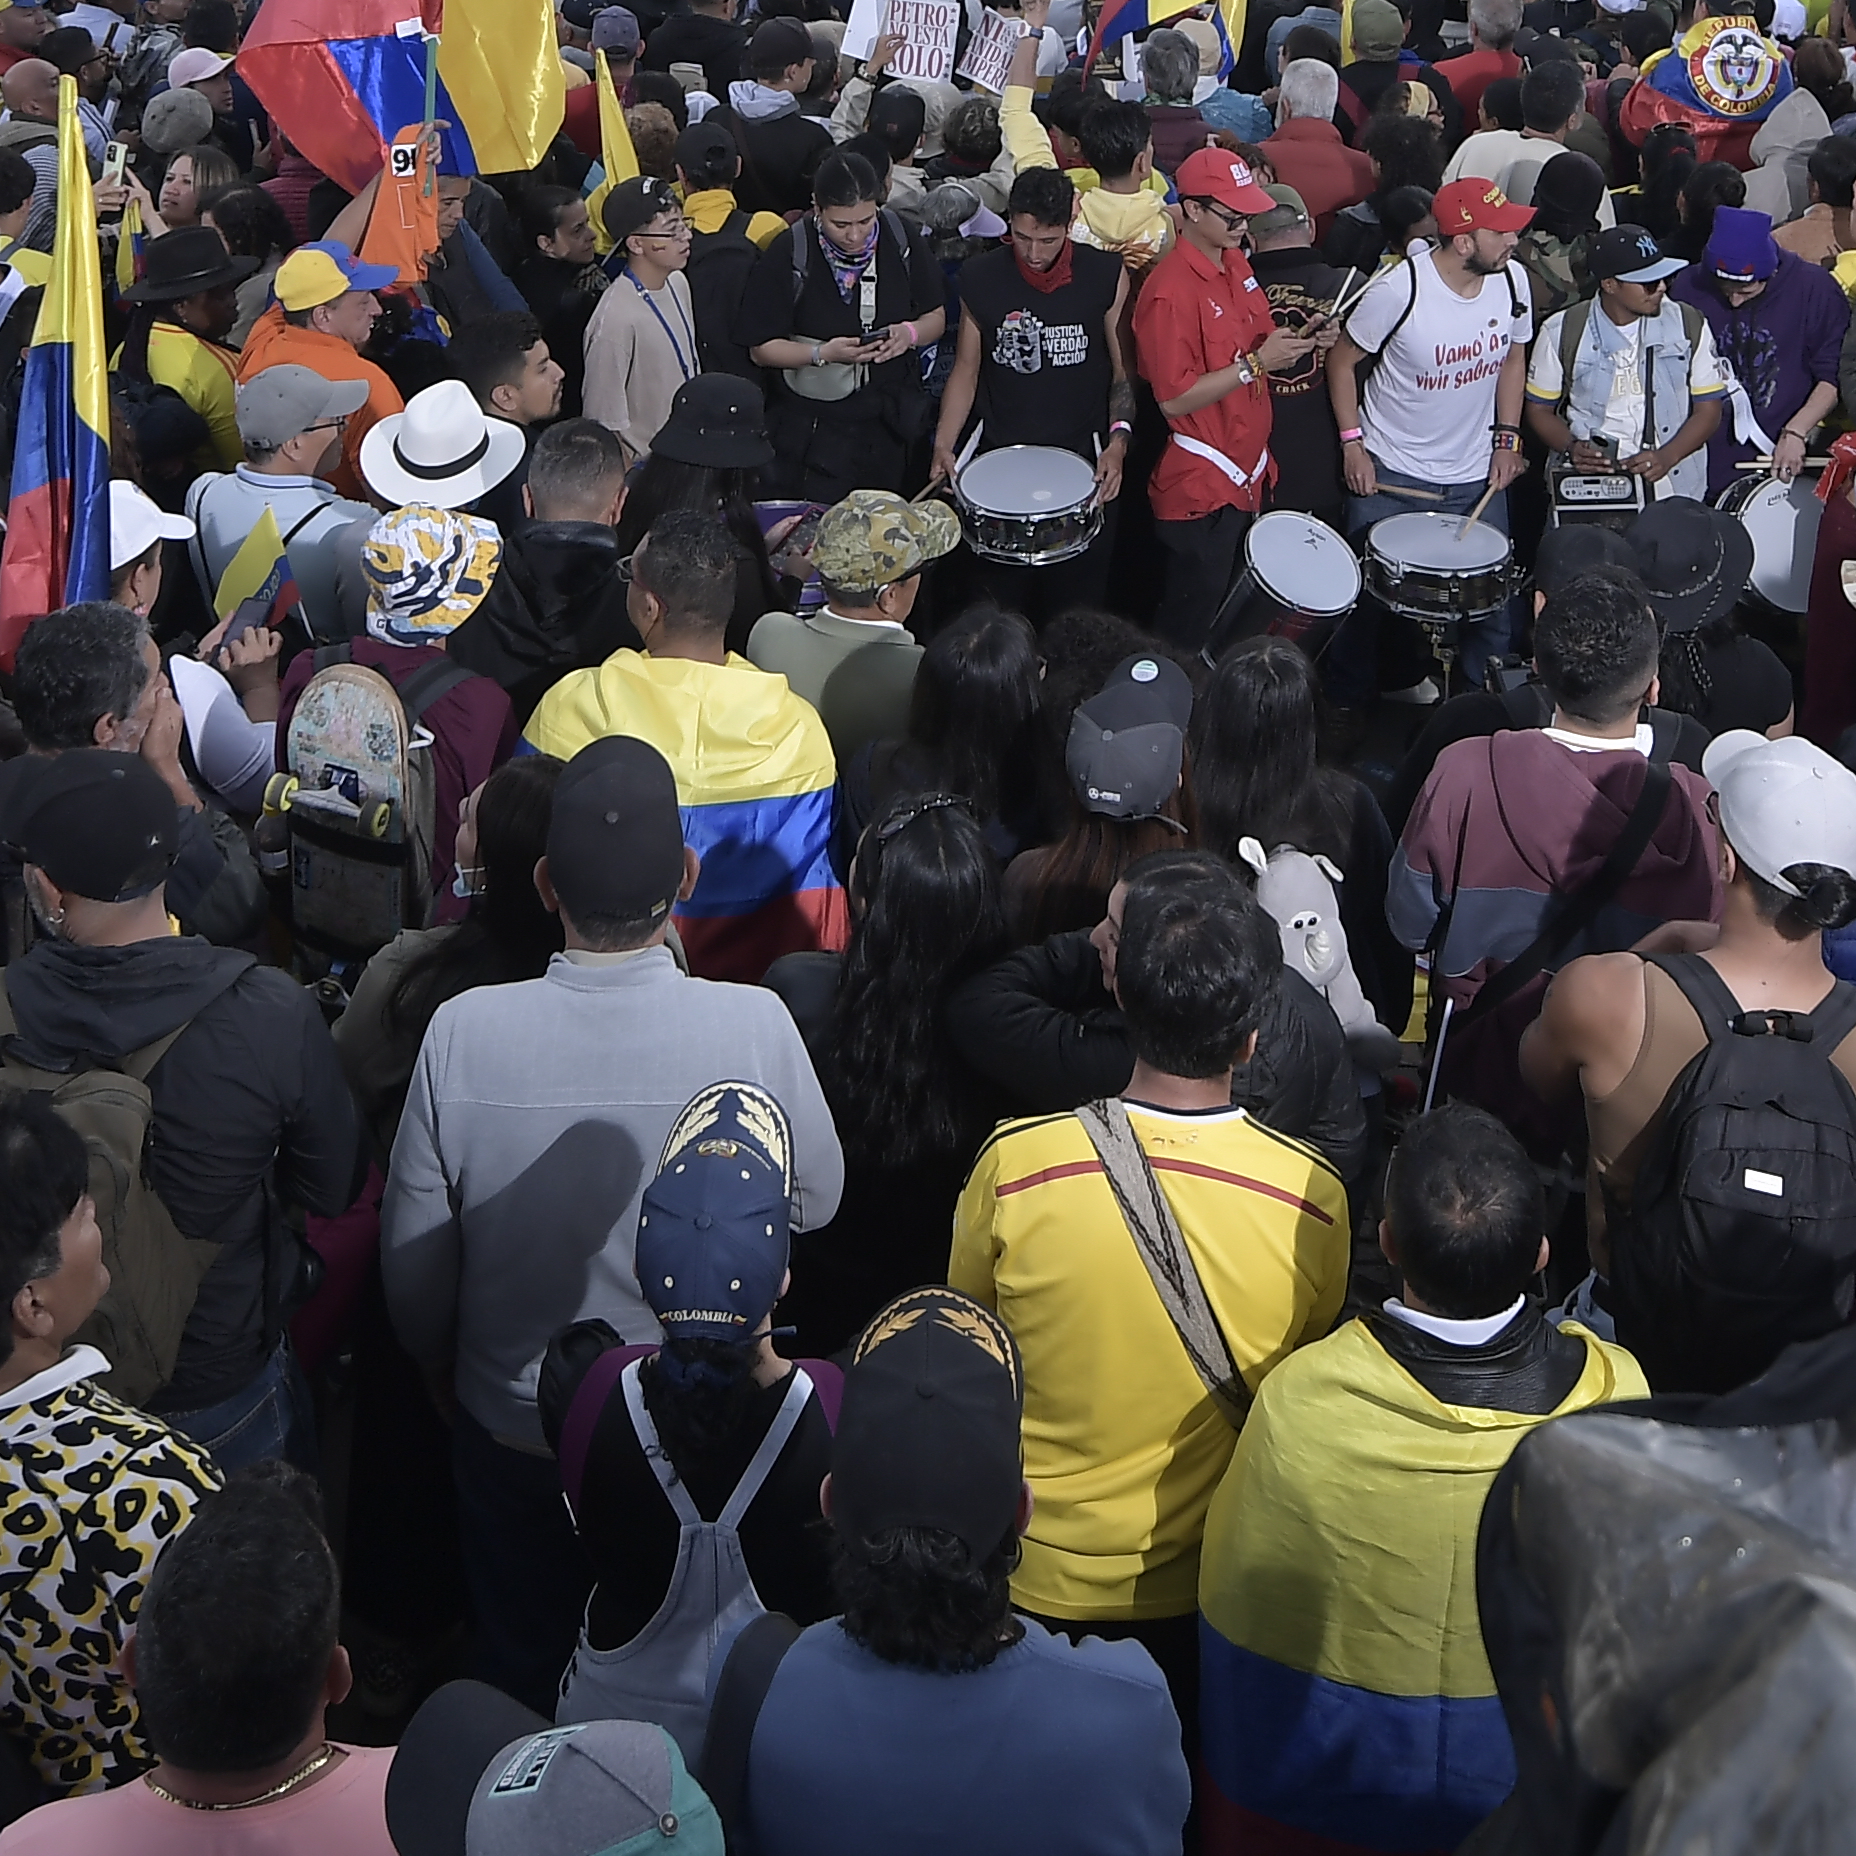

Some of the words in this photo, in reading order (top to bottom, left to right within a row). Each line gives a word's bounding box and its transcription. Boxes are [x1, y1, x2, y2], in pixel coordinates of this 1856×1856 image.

[890, 0, 948, 27] PETRO
[1710, 83, 1776, 113] COLOMBIA
[1044, 324, 1084, 339] JUSTICIA
[1046, 336, 1089, 353] VERDAD
[1416, 370, 1449, 391] vivir
[667, 1309, 734, 1324] COLOMBIA
